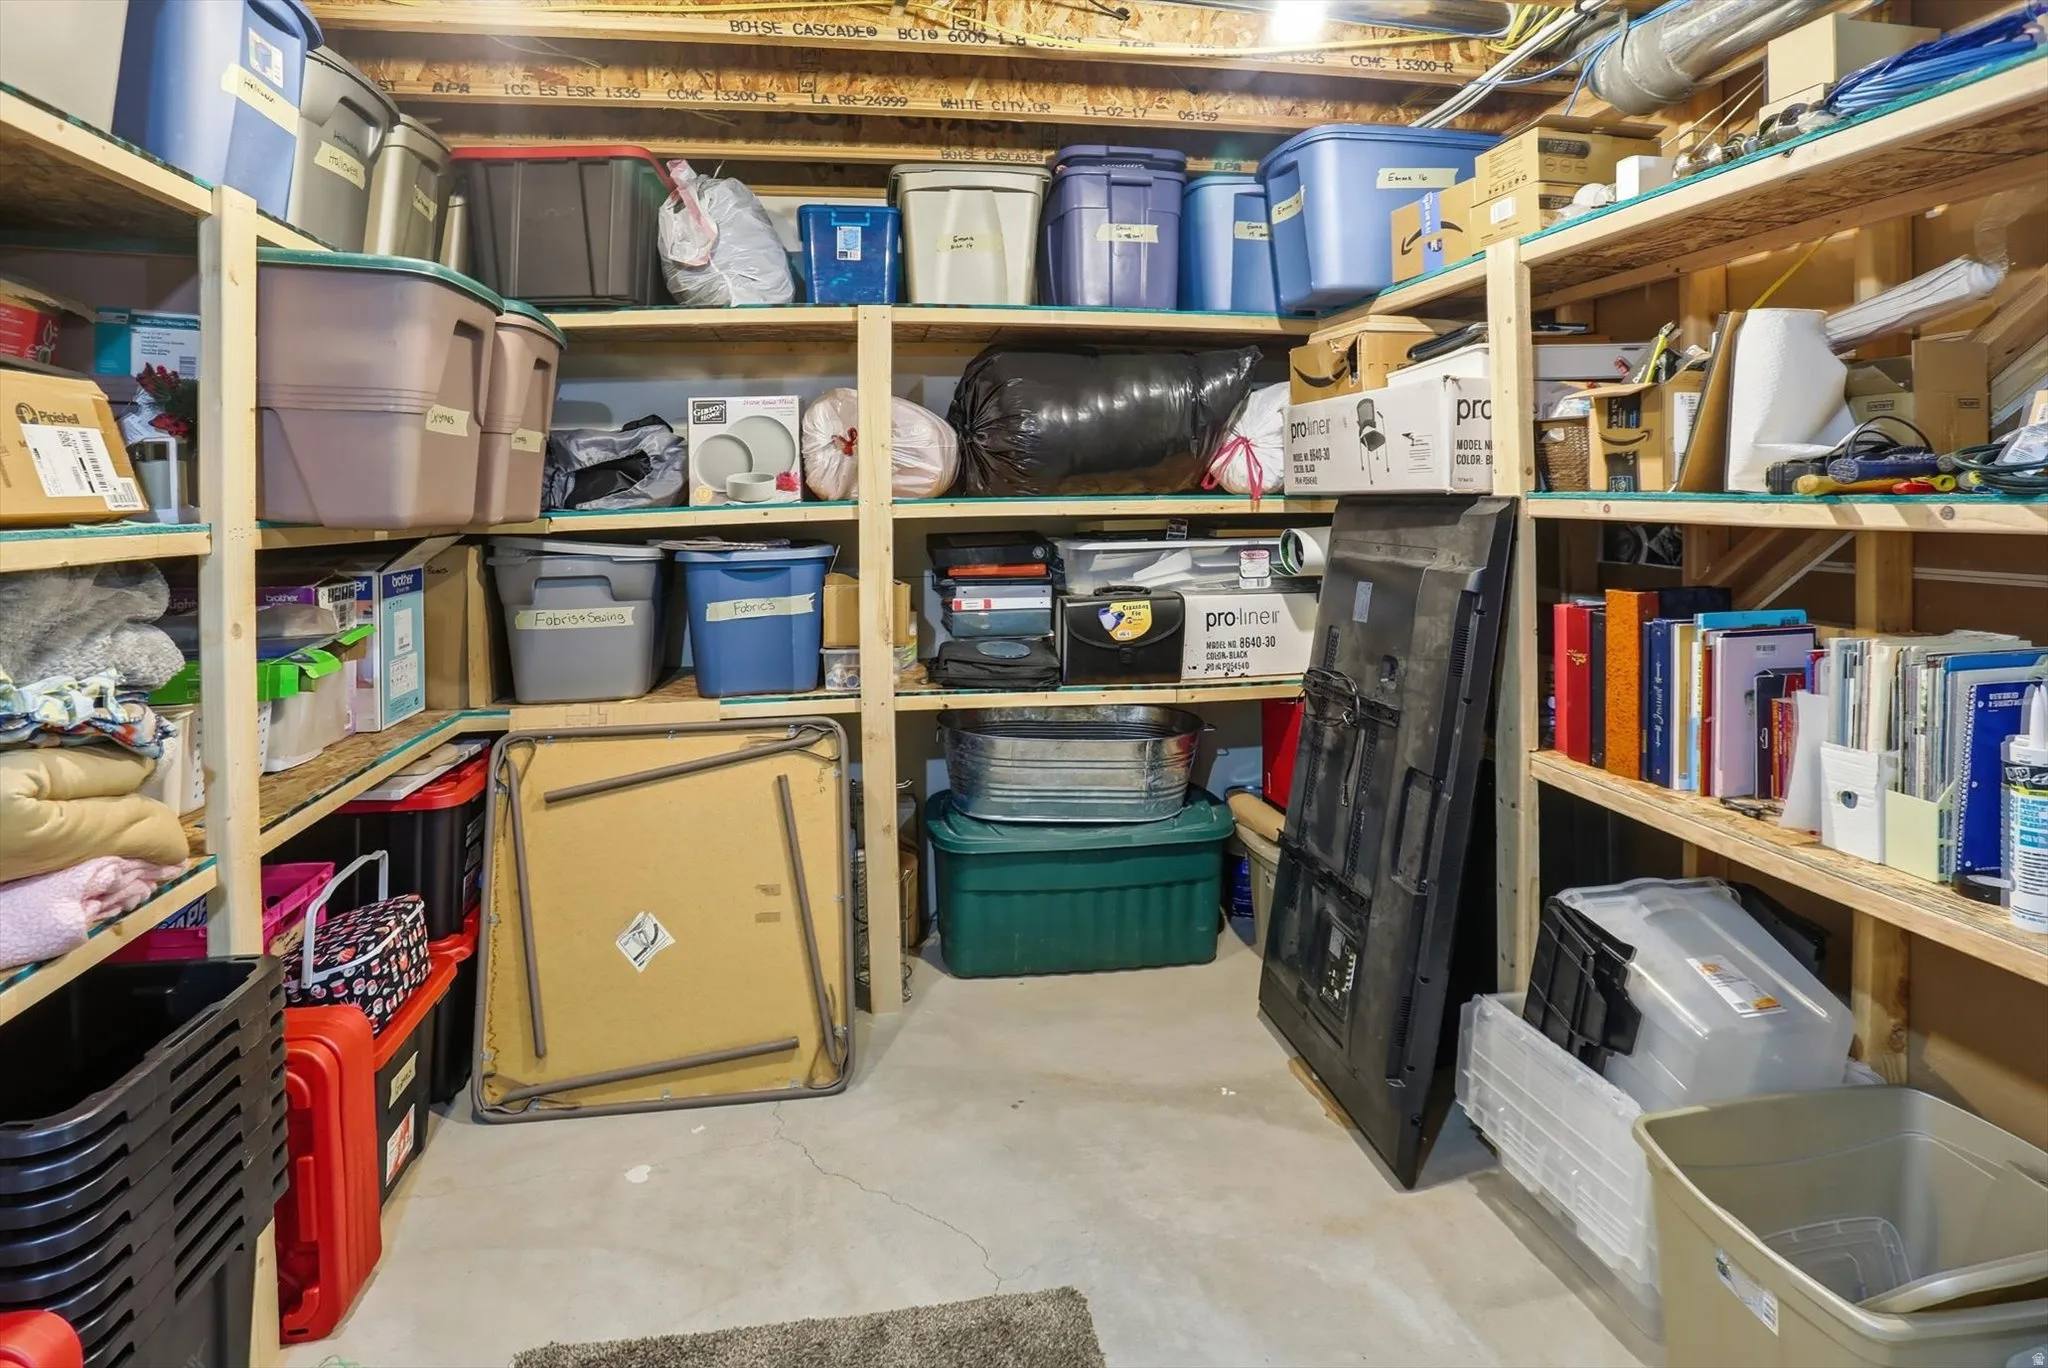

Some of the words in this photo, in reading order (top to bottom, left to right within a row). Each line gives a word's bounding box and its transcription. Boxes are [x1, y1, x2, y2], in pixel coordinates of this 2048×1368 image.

[730, 20, 783, 35] BOISE
[948, 30, 988, 44] 6000
[1350, 56, 1386, 70] CCMC
[1395, 58, 1454, 73] 13300-R
[432, 81, 470, 94] APA
[503, 83, 531, 96] ICC
[539, 85, 558, 97] ES
[566, 86, 596, 98] ESR
[605, 87, 641, 99] 1336
[667, 88, 705, 101] CCMC
[714, 90, 776, 103] 13300-R
[811, 93, 831, 105] LA
[941, 99, 984, 111] WHITE
[1083, 105, 1148, 119] 11-02-17
[1178, 109, 1219, 123] 06:59
[941, 149, 980, 161] BOISE
[693, 403, 726, 417] GIBSON
[38, 410, 80, 425] Pipishell
[1456, 439, 1483, 450] MODEL
[265, 594, 299, 603] brother
[733, 601, 776, 616] Fabrics
[1239, 635, 1276, 649] 8640-30
